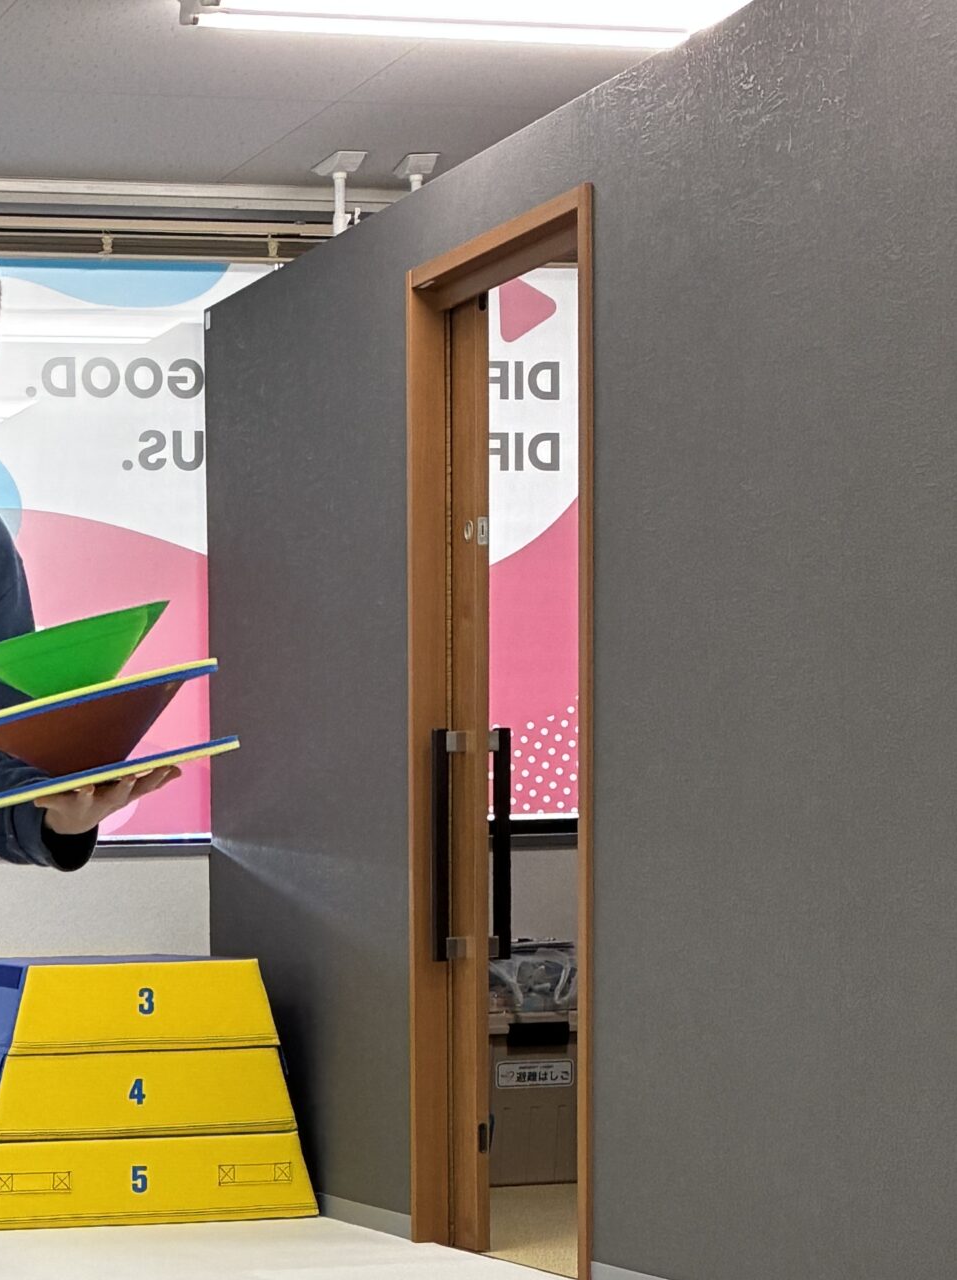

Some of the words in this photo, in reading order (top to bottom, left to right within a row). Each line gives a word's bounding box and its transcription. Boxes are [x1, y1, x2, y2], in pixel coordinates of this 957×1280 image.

[138, 987, 155, 1015] 3
[128, 1078, 146, 1105] 4
[130, 1165, 148, 1194] 5
